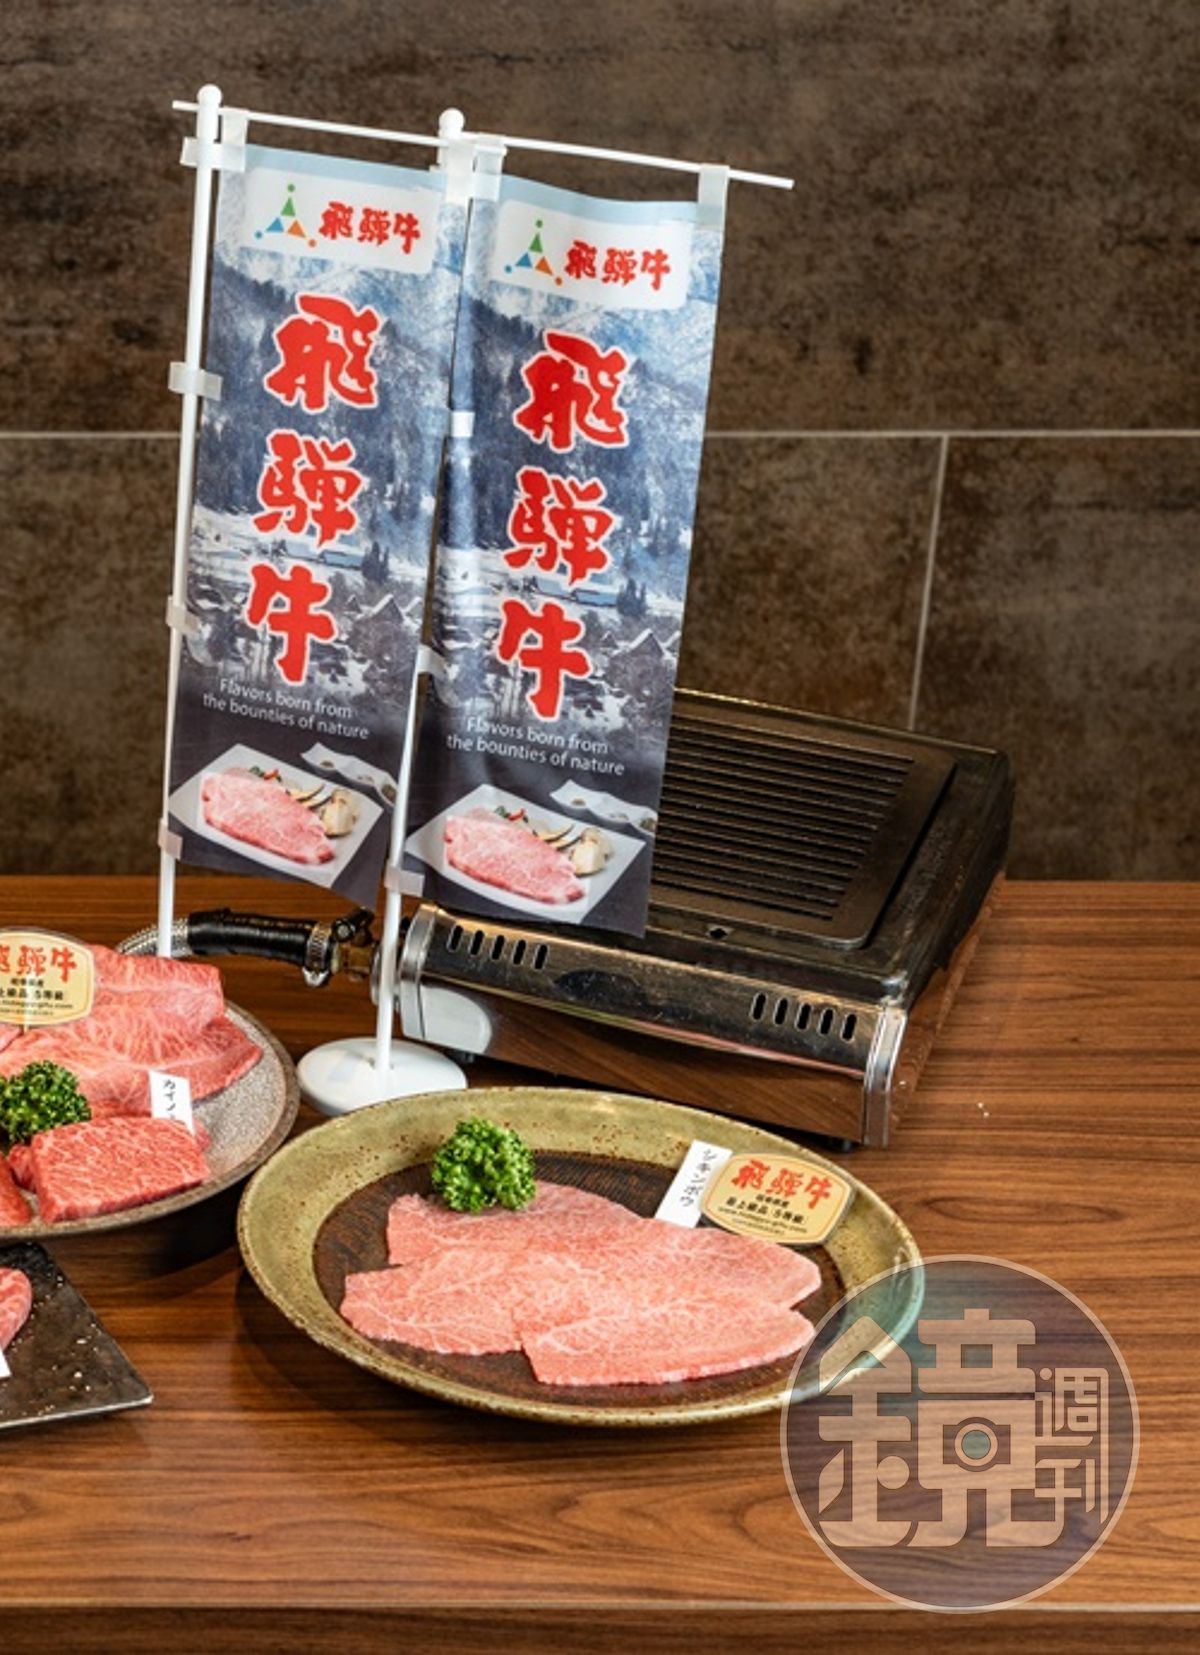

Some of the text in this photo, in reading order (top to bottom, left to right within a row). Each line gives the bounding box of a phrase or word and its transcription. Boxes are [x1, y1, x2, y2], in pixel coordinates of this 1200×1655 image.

[318, 200, 422, 254] 飛騨牛
[565, 240, 672, 291] 飛騨牛
[247, 294, 381, 684] 飛騨牛
[497, 330, 629, 720] 飛騨牛
[202, 693, 369, 739] the bounties of nature
[220, 678, 351, 718] Flavors born from
[446, 735, 625, 775] the bounties of nature
[467, 717, 608, 754] Flavors born from
[163, 1079, 176, 1119] カイノ
[731, 1158, 832, 1209] 飛騨牛
